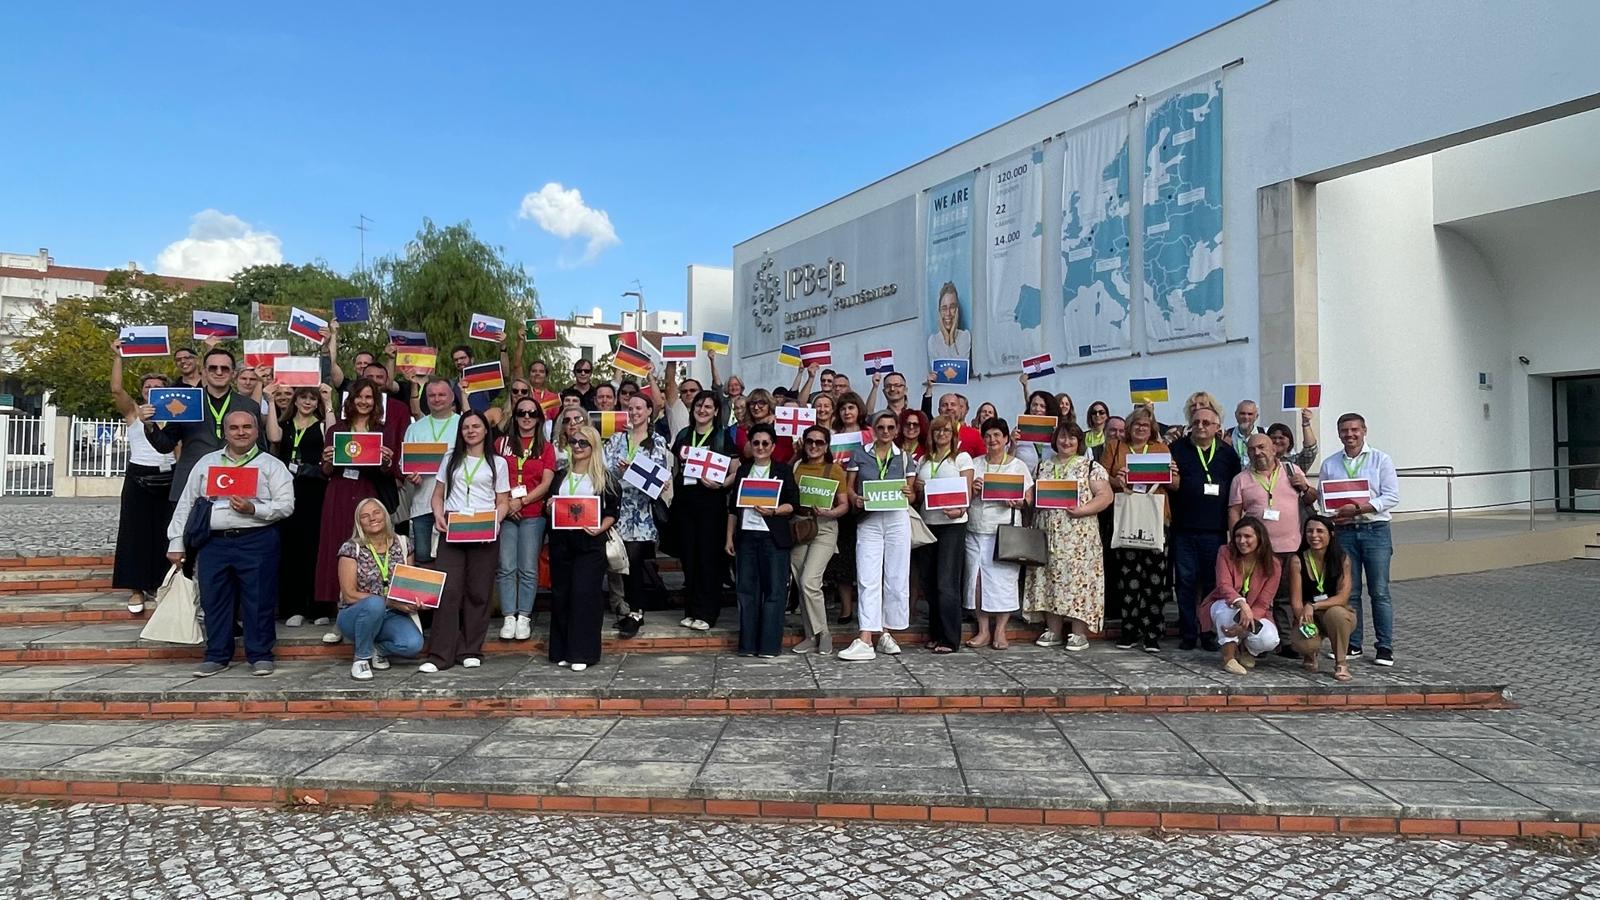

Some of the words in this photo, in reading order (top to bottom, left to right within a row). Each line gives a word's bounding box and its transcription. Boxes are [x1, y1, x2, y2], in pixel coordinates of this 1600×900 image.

[997, 164, 1028, 184] 120.000
[934, 195, 948, 212] WE
[950, 187, 969, 207] ARE
[995, 204, 1006, 215] 22
[994, 230, 1021, 246] 14.000
[784, 256, 847, 302] IPBeja
[867, 490, 904, 502] WEEK
